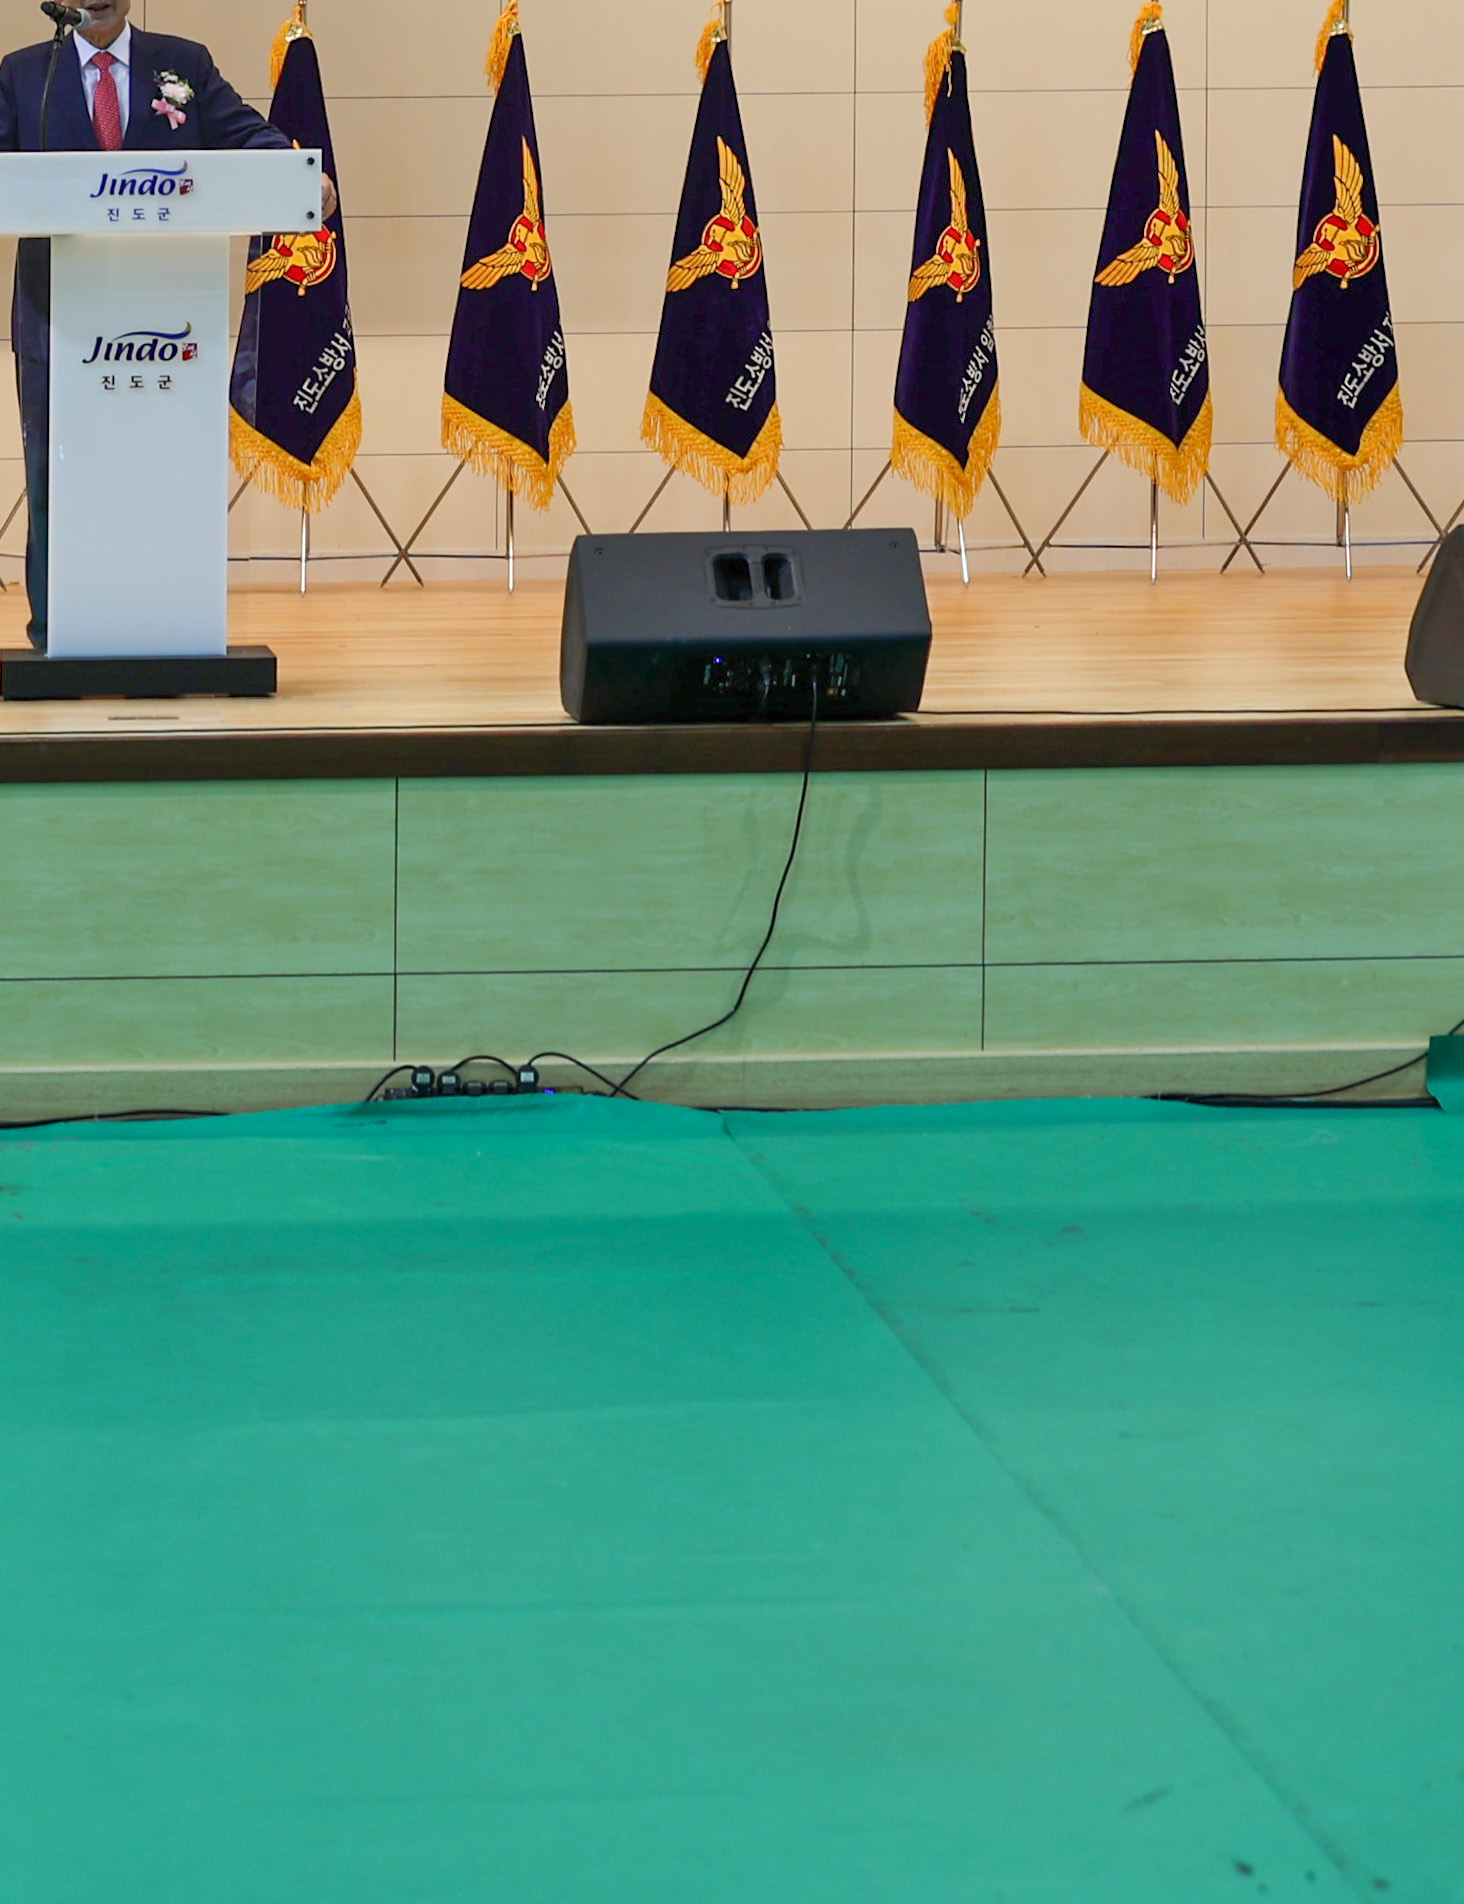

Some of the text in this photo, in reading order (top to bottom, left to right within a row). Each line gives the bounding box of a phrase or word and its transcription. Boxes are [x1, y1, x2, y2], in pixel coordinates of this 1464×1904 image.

[90, 172, 176, 198] Jindo
[82, 336, 178, 364] Jindo
[293, 332, 352, 414] 진도소방서
[725, 331, 773, 412] 진도소방서
[1337, 329, 1394, 409] 진도소방서
